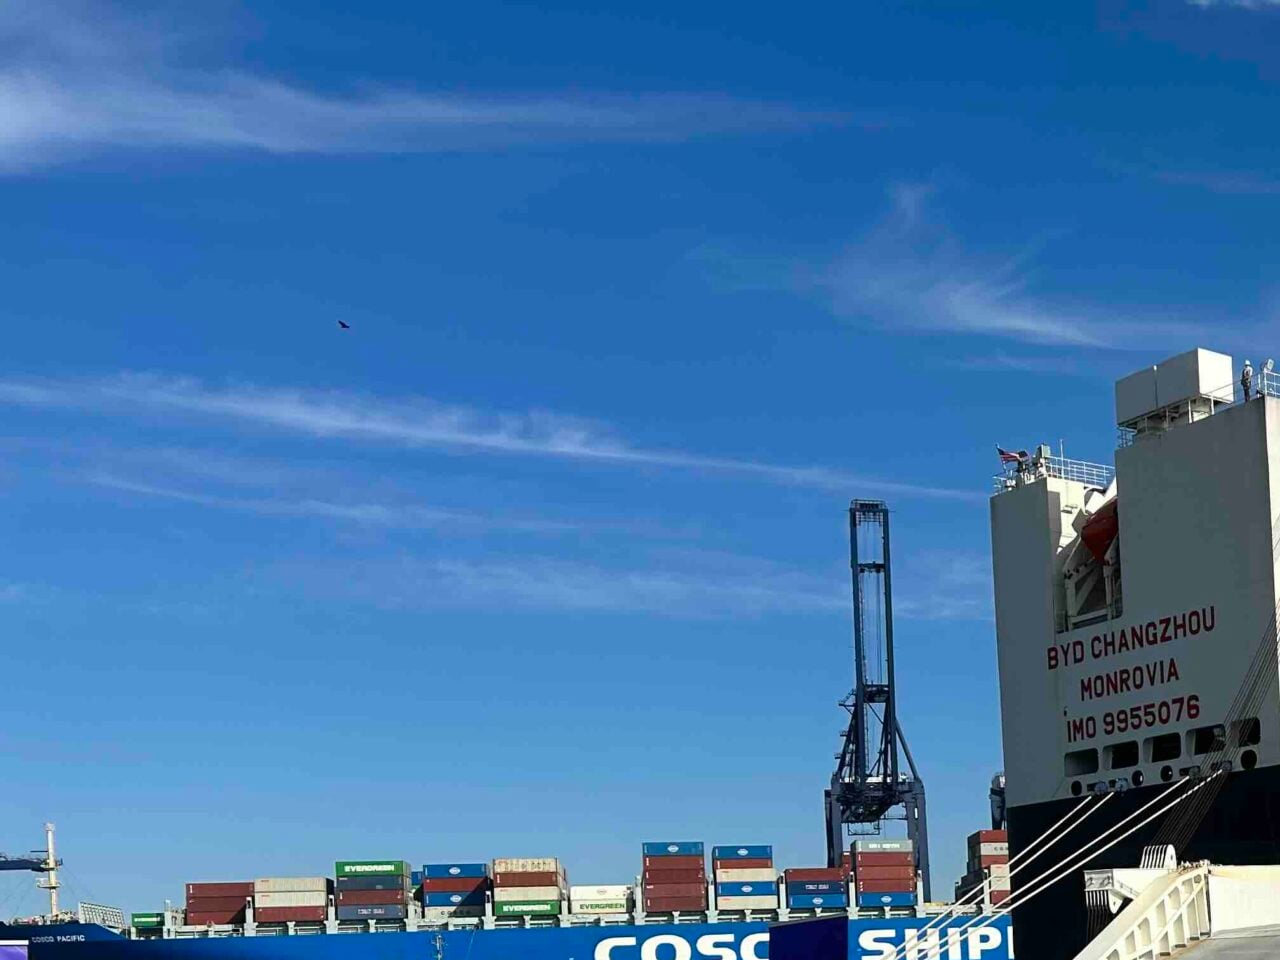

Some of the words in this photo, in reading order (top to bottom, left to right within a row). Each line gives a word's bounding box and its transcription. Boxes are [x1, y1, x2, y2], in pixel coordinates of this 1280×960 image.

[1047, 640, 1085, 670] BYD
[1090, 605, 1216, 660] CHANGZHOU
[1080, 657, 1180, 702] MONROVIA
[1067, 716, 1097, 743] IMO
[1103, 694, 1200, 736] 9955076
[344, 864, 395, 872] EVERGREEN
[503, 904, 551, 912] EVERGREEN
[580, 902, 625, 910] EVERGREEN
[56, 934, 86, 942] PACIFIC
